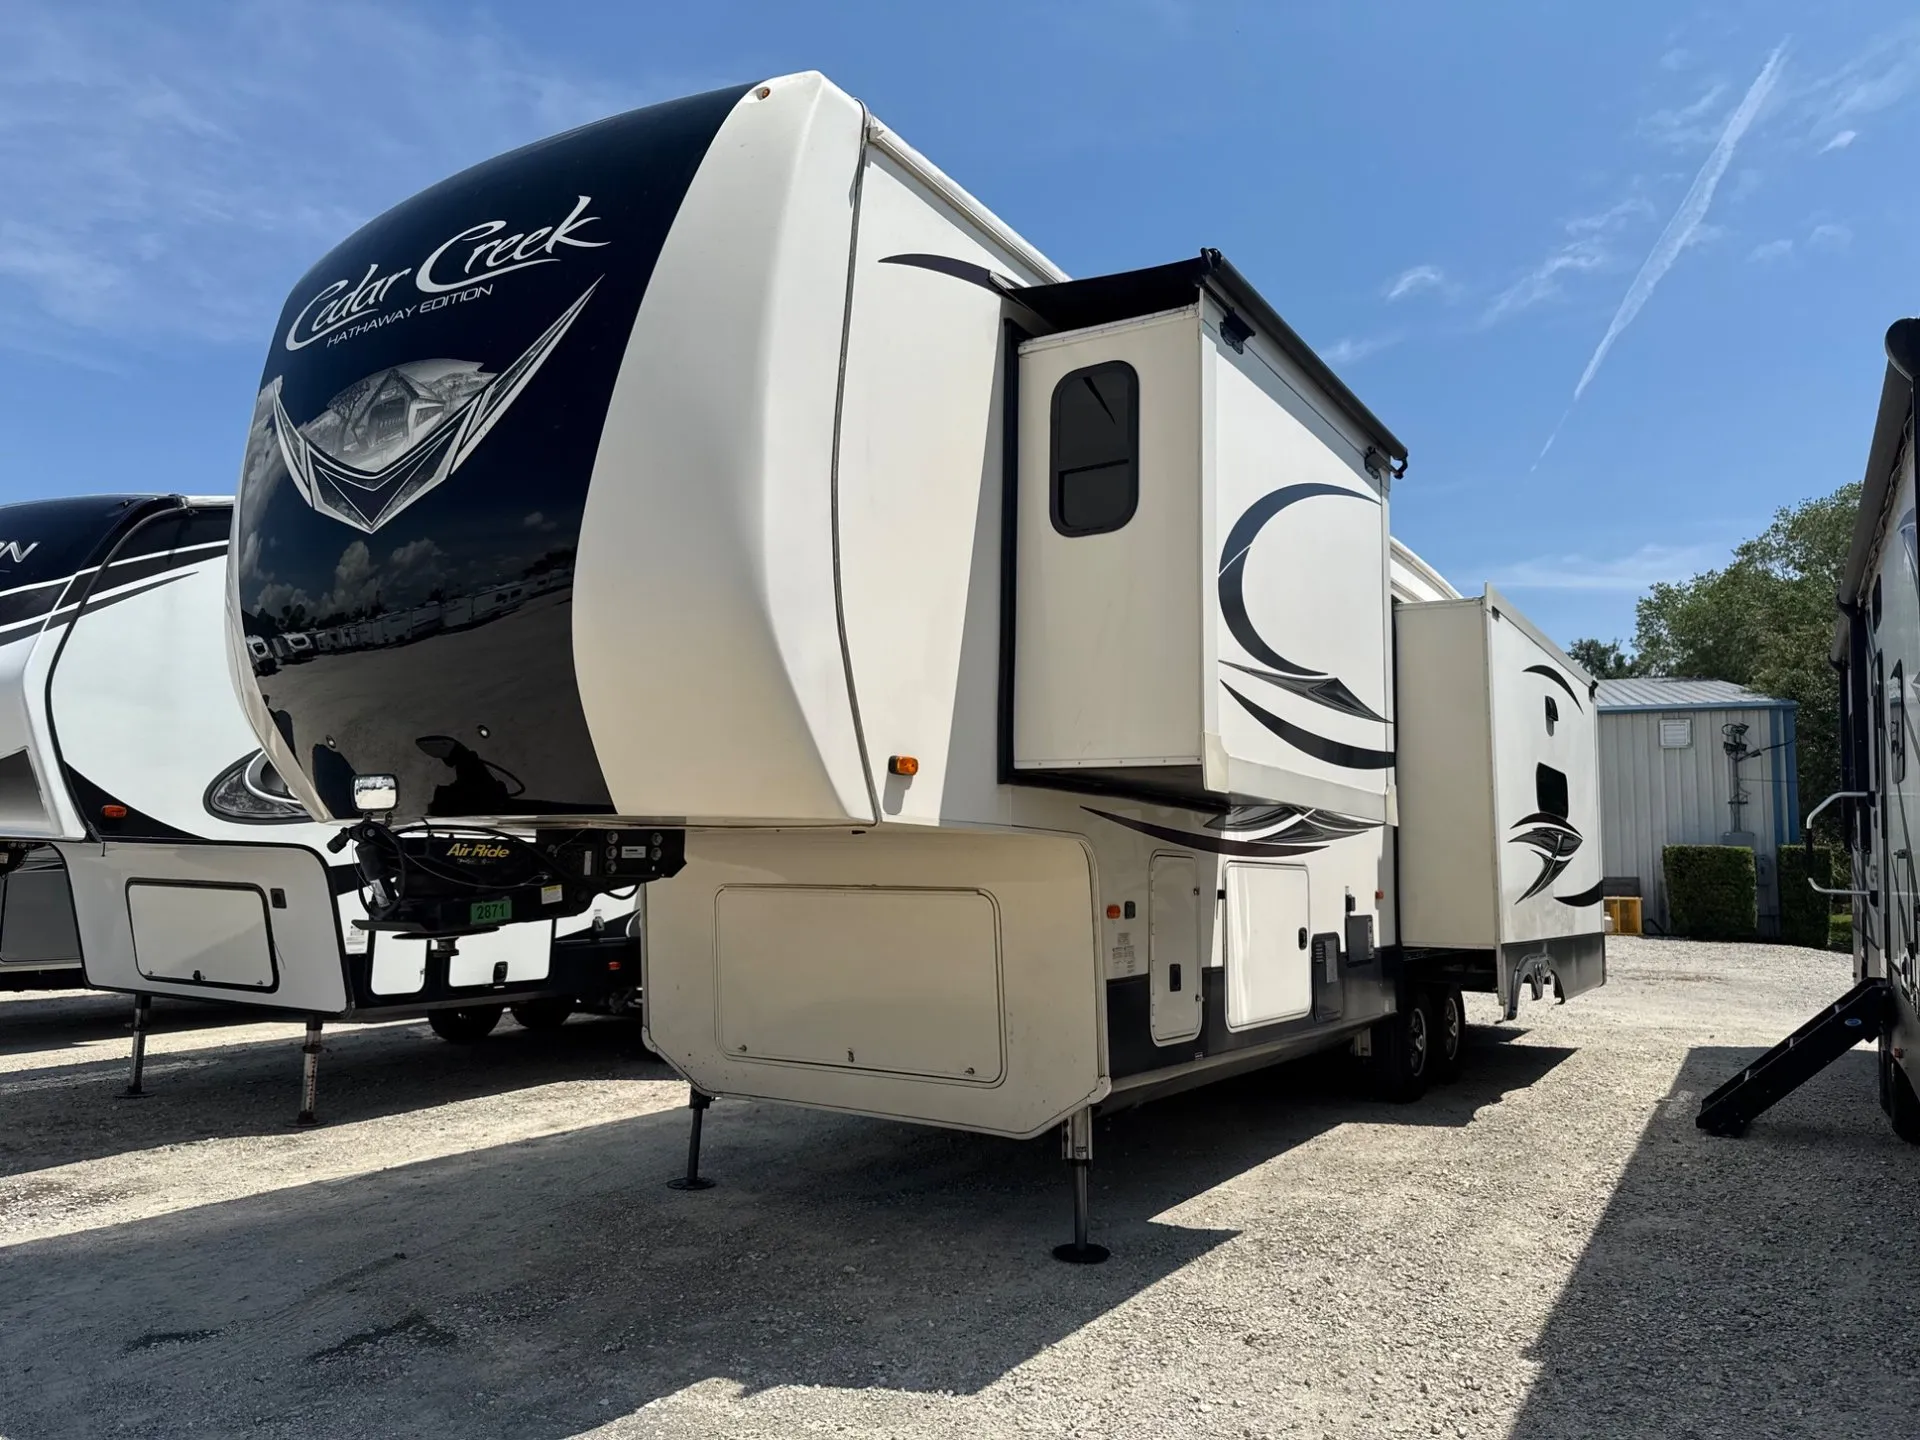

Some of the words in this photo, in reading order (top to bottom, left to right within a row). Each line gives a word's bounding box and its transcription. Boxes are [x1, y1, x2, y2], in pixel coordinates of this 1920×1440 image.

[285, 263, 412, 351] Cedar
[416, 195, 611, 293] Creek
[326, 305, 416, 348] HATHAWAY
[419, 284, 493, 314] EDITION
[446, 843, 473, 857] Air
[471, 844, 510, 858] Ride
[476, 903, 506, 919] 2871
